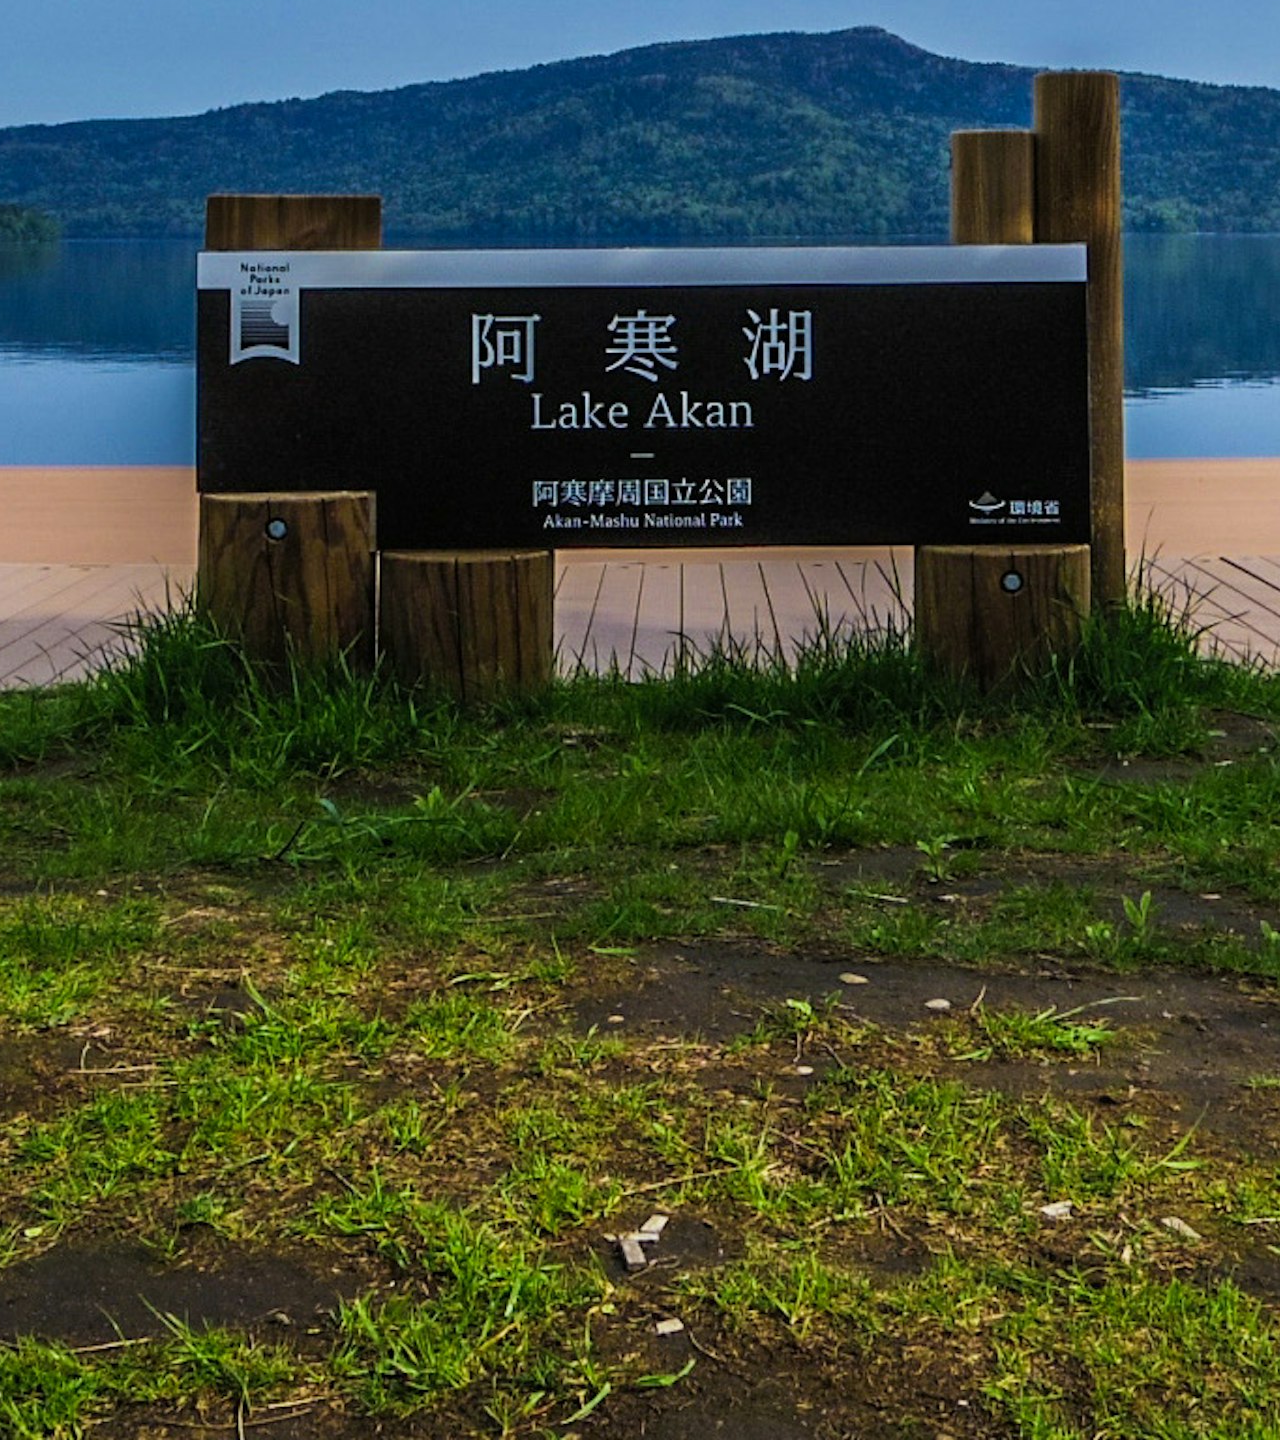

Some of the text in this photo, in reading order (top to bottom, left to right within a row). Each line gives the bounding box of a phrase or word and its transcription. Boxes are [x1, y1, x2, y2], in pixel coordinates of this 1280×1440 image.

[240, 262, 290, 272] National
[250, 274, 280, 283] Parks
[240, 286, 290, 297] of Japan
[471, 308, 813, 384] 阿寒湖
[530, 391, 755, 430] Lake Akan
[532, 477, 752, 507] 阿寒摩周国立公園
[543, 512, 744, 529] Akan-Mashu National Park
